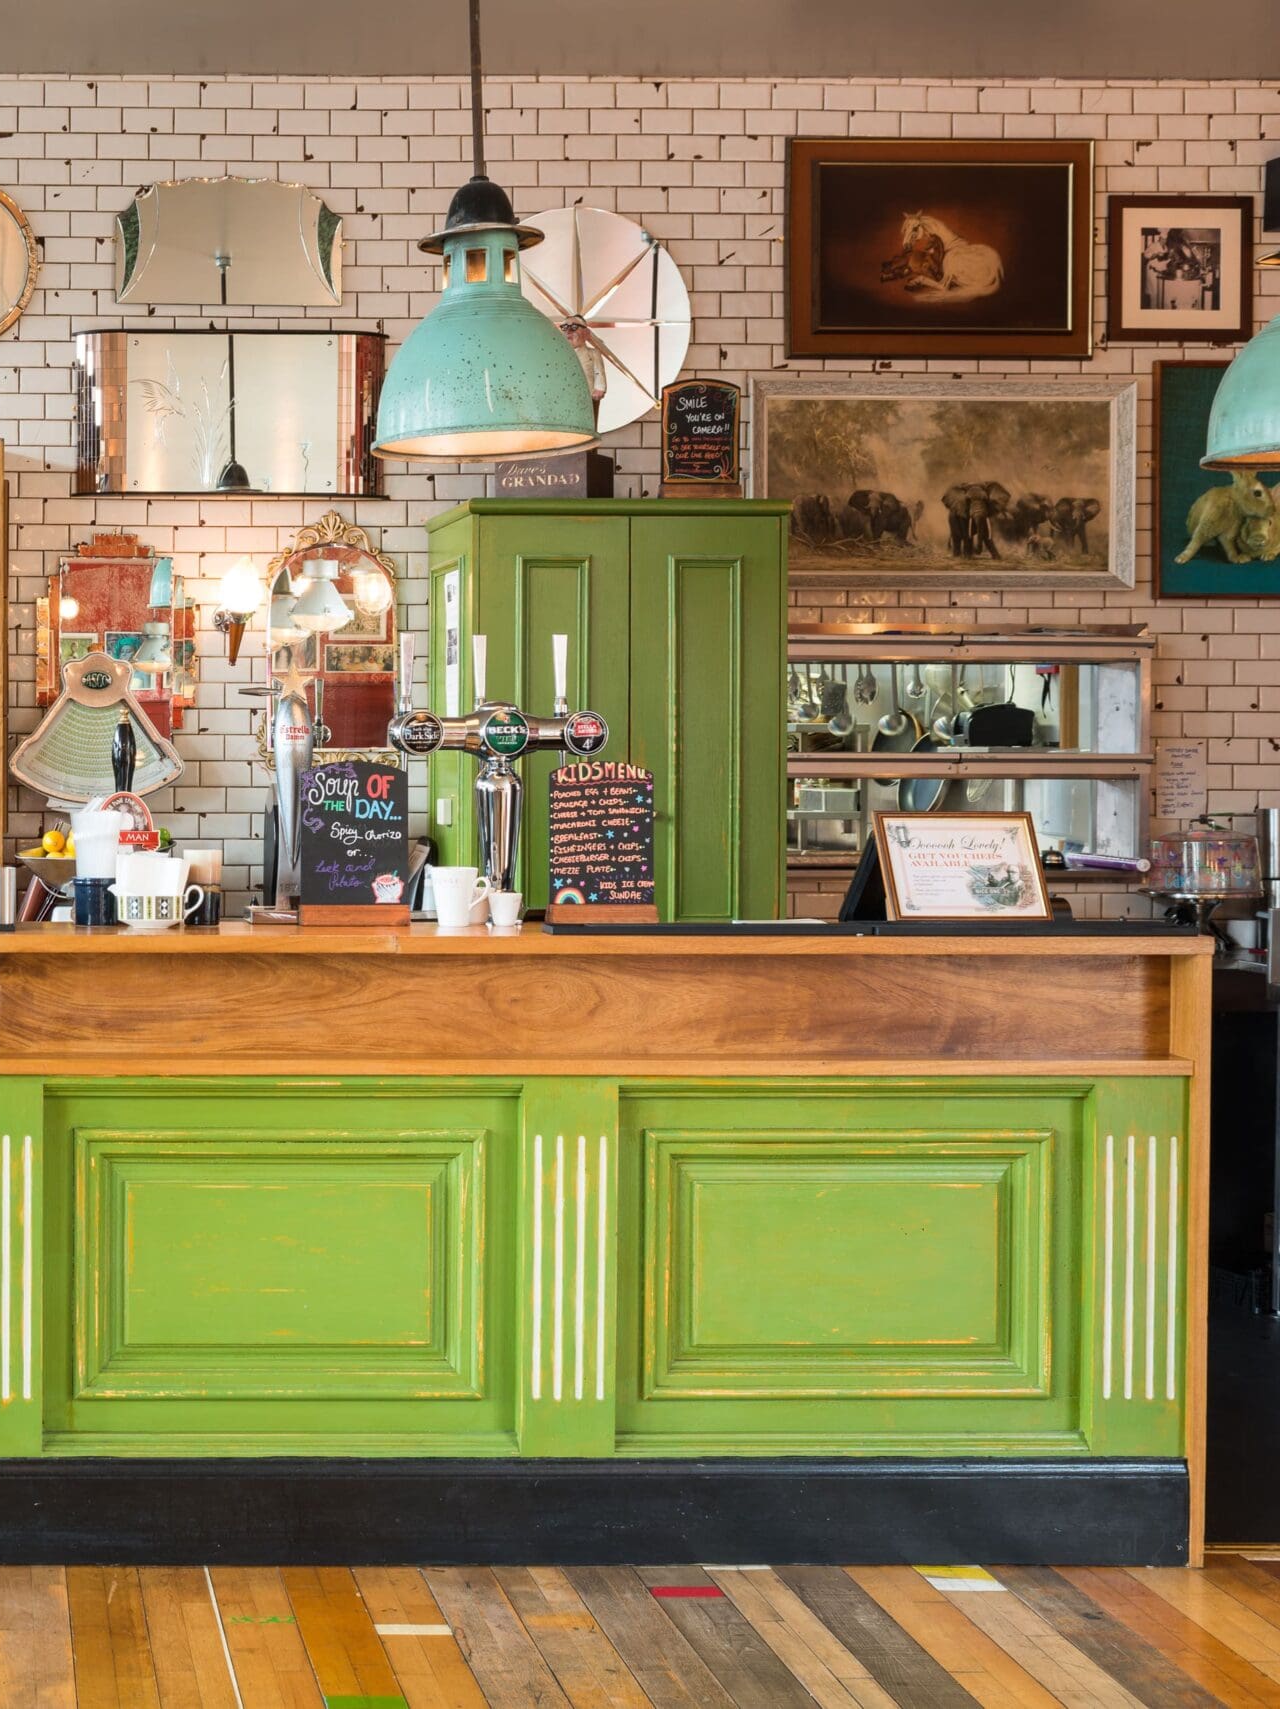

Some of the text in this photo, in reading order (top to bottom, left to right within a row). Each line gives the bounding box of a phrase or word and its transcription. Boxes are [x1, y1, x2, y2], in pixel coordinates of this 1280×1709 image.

[676, 396, 708, 411] SMILE
[685, 412, 725, 423] YOU'RE ON
[502, 474, 580, 487] GRANDAD
[486, 725, 526, 734] BECK'S
[556, 761, 648, 783] KIDS MENU
[308, 772, 395, 813] Soup OF
[610, 787, 632, 795] BEANS
[323, 799, 402, 821] THE DAY...
[553, 800, 588, 809] SAUSAGE
[553, 820, 596, 830] MACARONI
[127, 833, 150, 841] MAN
[330, 822, 402, 845] Spicy Chorizo
[554, 833, 598, 844] BREAKFAST
[961, 836, 1006, 852] Lovely!
[909, 852, 1003, 860] GIFT VOUCHERS
[345, 858, 376, 872] and
[586, 865, 611, 873] PLATE
[600, 881, 617, 889] KIDS
[609, 890, 642, 899] SUNDAE
